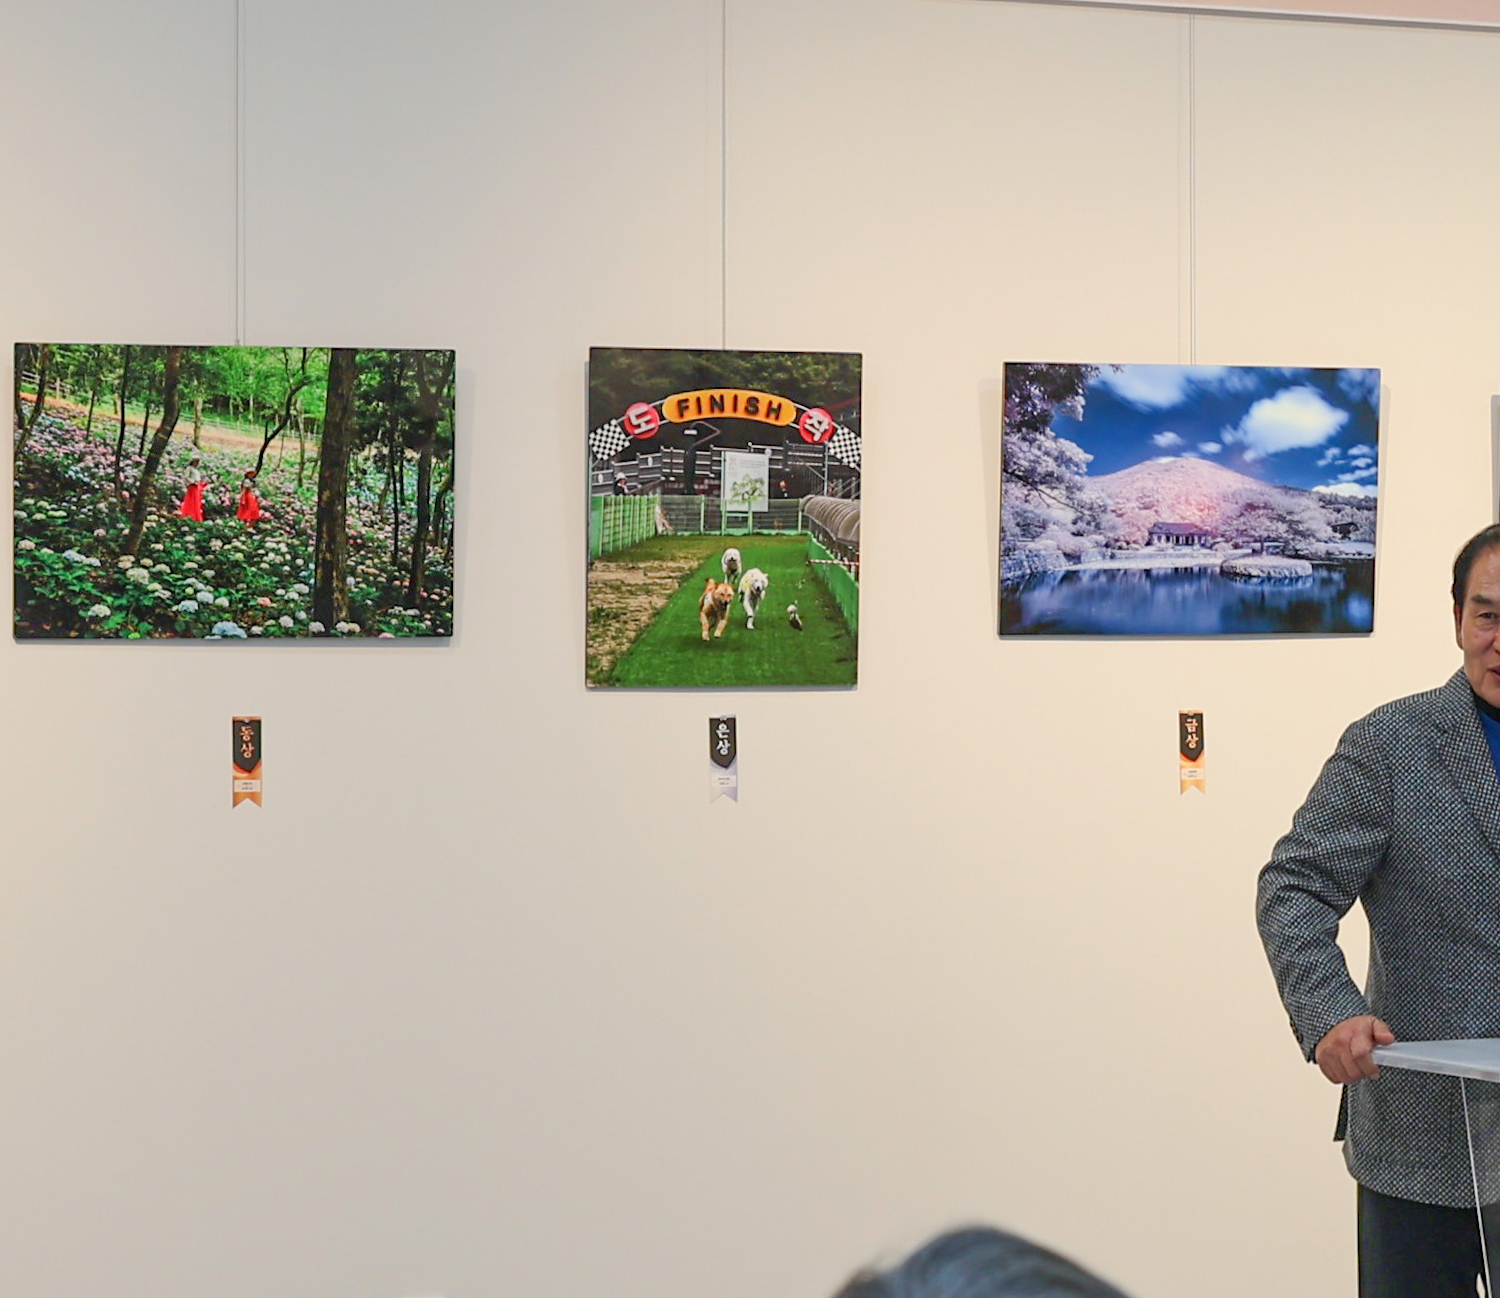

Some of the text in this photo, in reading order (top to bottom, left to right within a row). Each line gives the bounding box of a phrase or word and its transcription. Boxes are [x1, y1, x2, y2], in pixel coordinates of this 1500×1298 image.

[675, 393, 783, 421] FINISH
[240, 725, 255, 759] 동상
[715, 723, 731, 756] 은상
[1184, 718, 1199, 749] 금상
